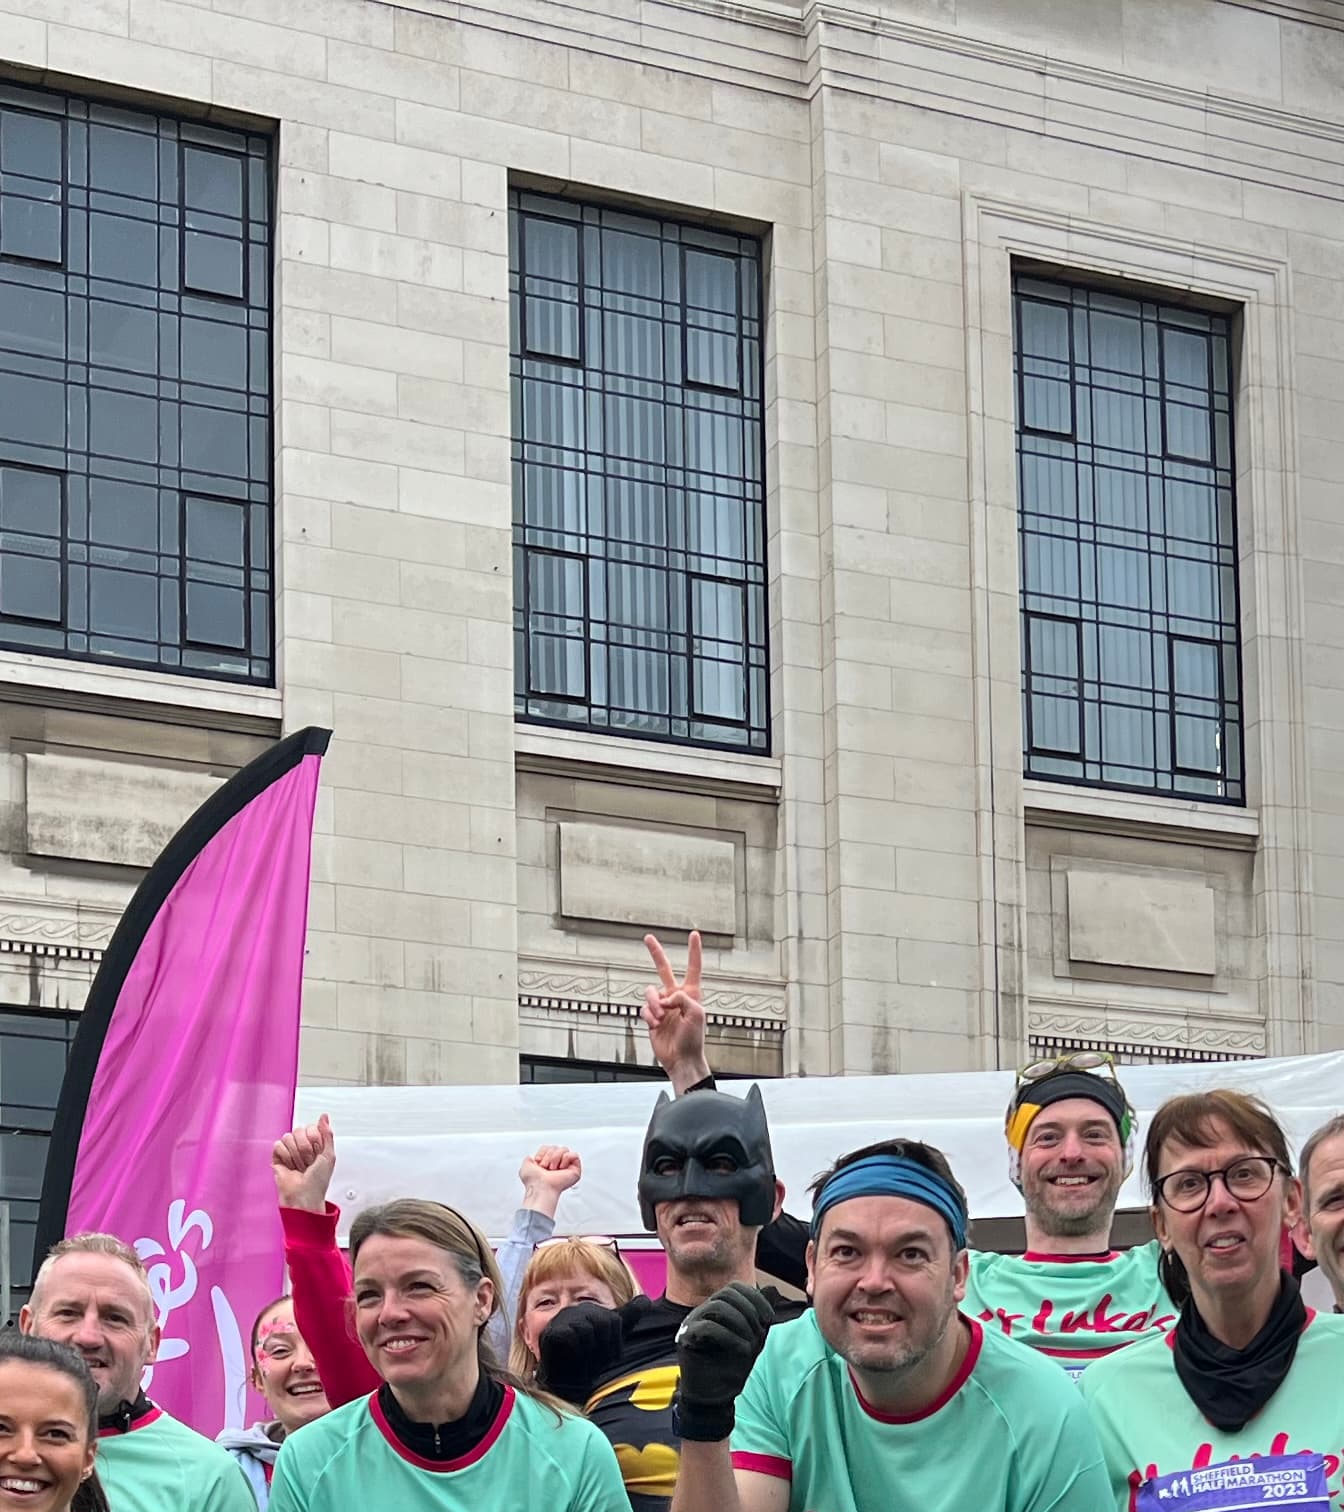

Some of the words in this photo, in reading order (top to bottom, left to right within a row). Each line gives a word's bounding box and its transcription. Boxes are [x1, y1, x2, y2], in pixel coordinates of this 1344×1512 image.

[1192, 1466, 1252, 1484] SHEFFIELD
[1192, 1480, 1225, 1493] HALF
[1226, 1470, 1304, 1487] MARATHON
[1262, 1484, 1308, 1499] 2023
